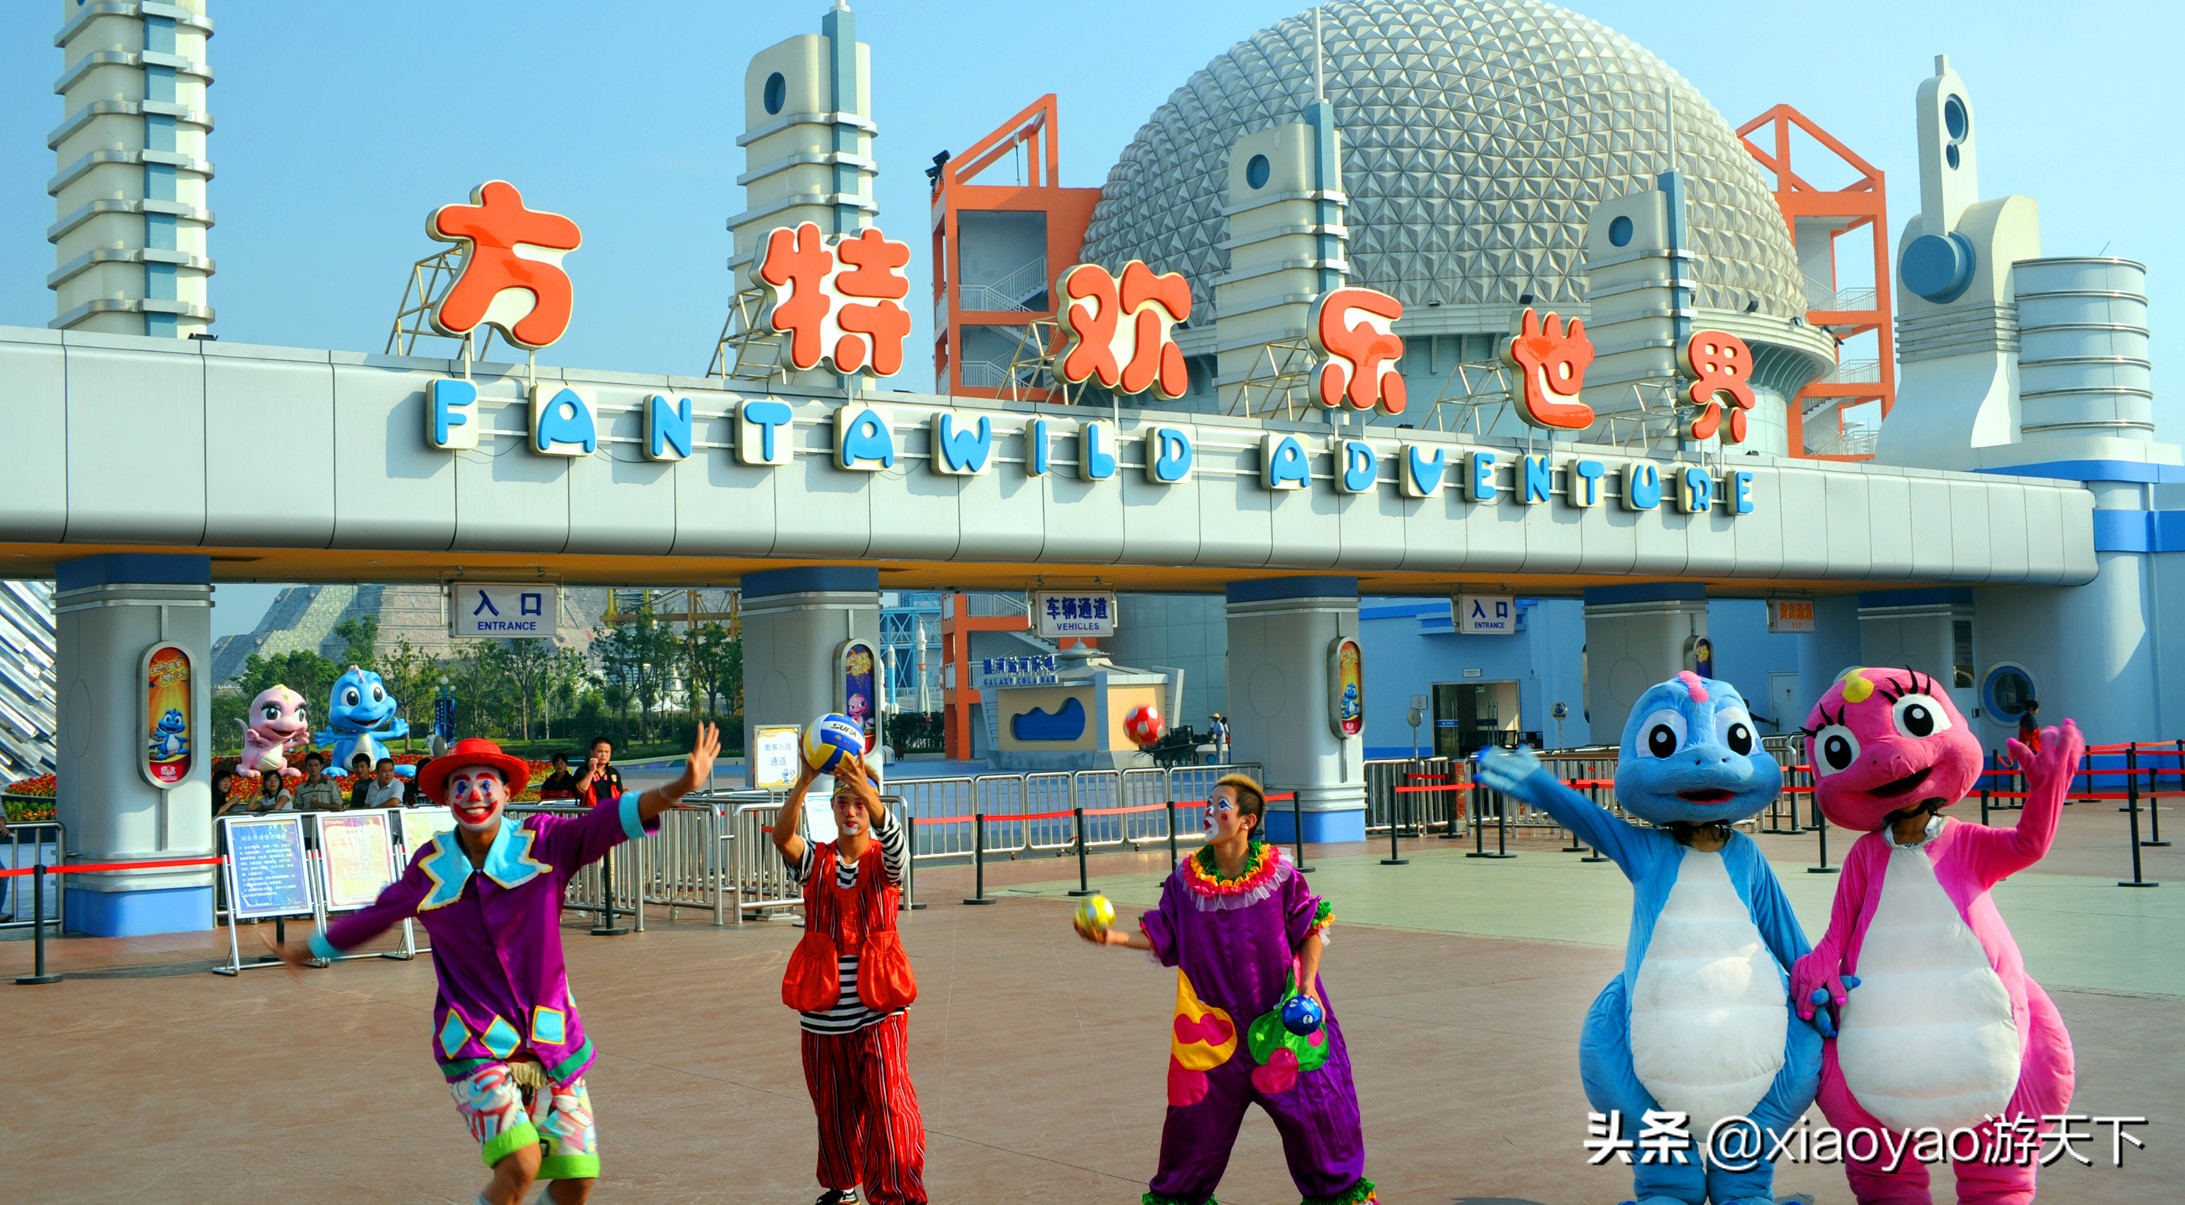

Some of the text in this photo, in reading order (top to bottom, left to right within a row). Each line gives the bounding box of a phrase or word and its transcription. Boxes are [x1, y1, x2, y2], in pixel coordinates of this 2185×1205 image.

[427, 179, 1756, 446] 方特欢乐世界
[432, 378, 1755, 514] FANTAWILD ADVENTURE
[473, 589, 541, 616] 入口
[1046, 597, 1108, 620] 车辆通道
[1472, 599, 1508, 618] 入口
[477, 621, 537, 631] ENTRANCE
[1056, 622, 1100, 631] VEHICLES
[1474, 621, 1505, 629] ENTRANCE
[983, 674, 1057, 686] GALAXY COLA BAR
[769, 755, 787, 767] 通道
